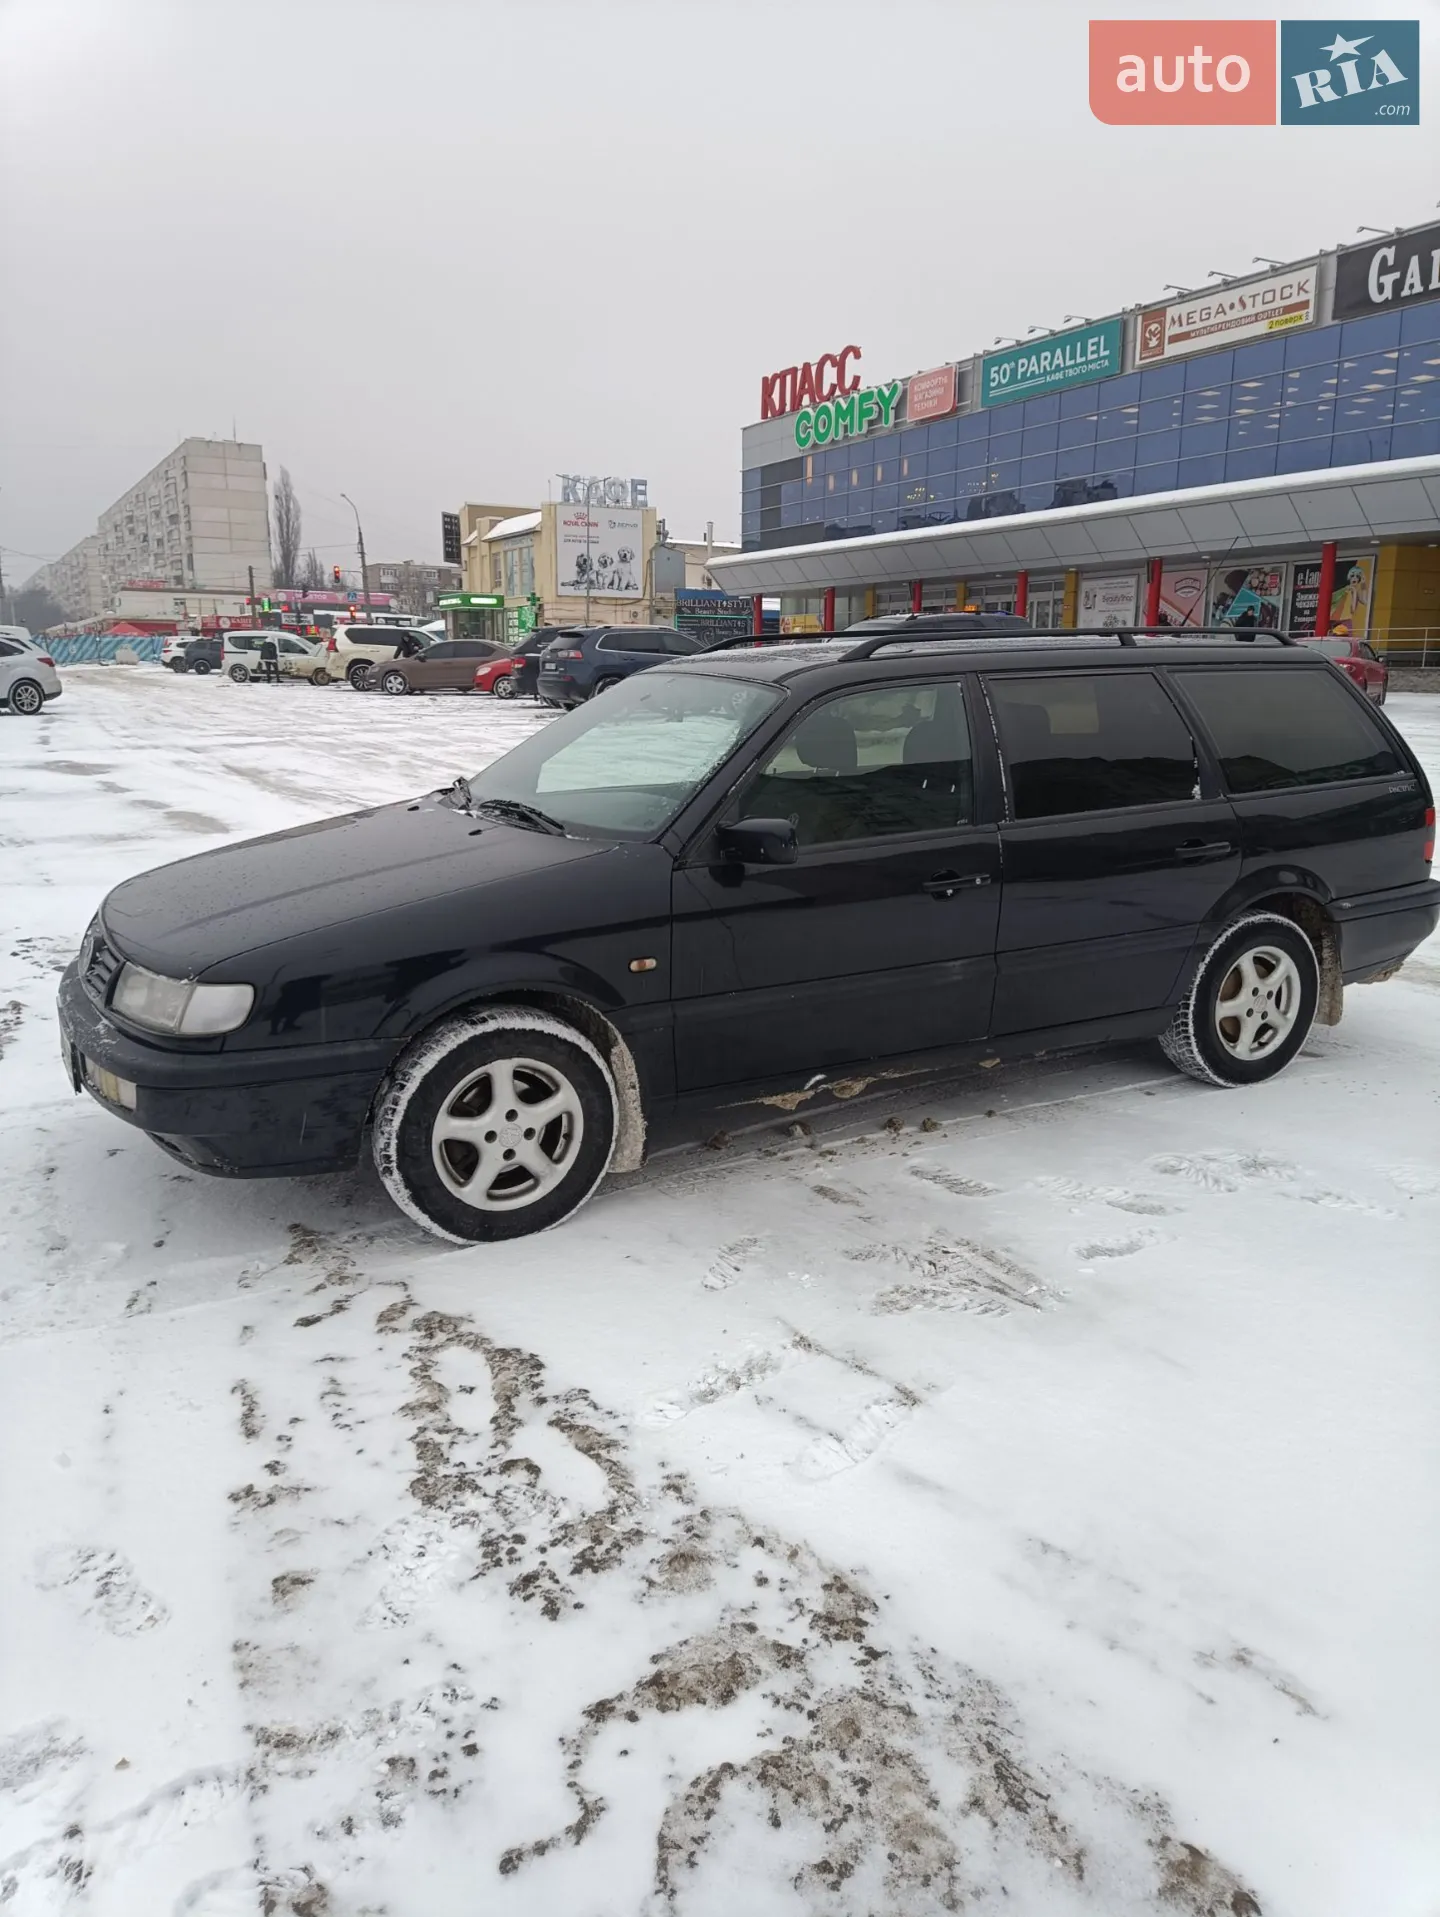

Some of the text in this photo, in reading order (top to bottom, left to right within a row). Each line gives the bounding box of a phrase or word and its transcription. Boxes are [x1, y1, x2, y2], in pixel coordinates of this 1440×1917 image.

[1256, 307, 1284, 320] OUTLET
[1268, 320, 1274, 329] 2
[1017, 335, 1110, 380] PARALLEL
[1046, 368, 1064, 383] КАФЕ
[1065, 364, 1088, 377] ТВОГО
[795, 380, 902, 449] COMFY
